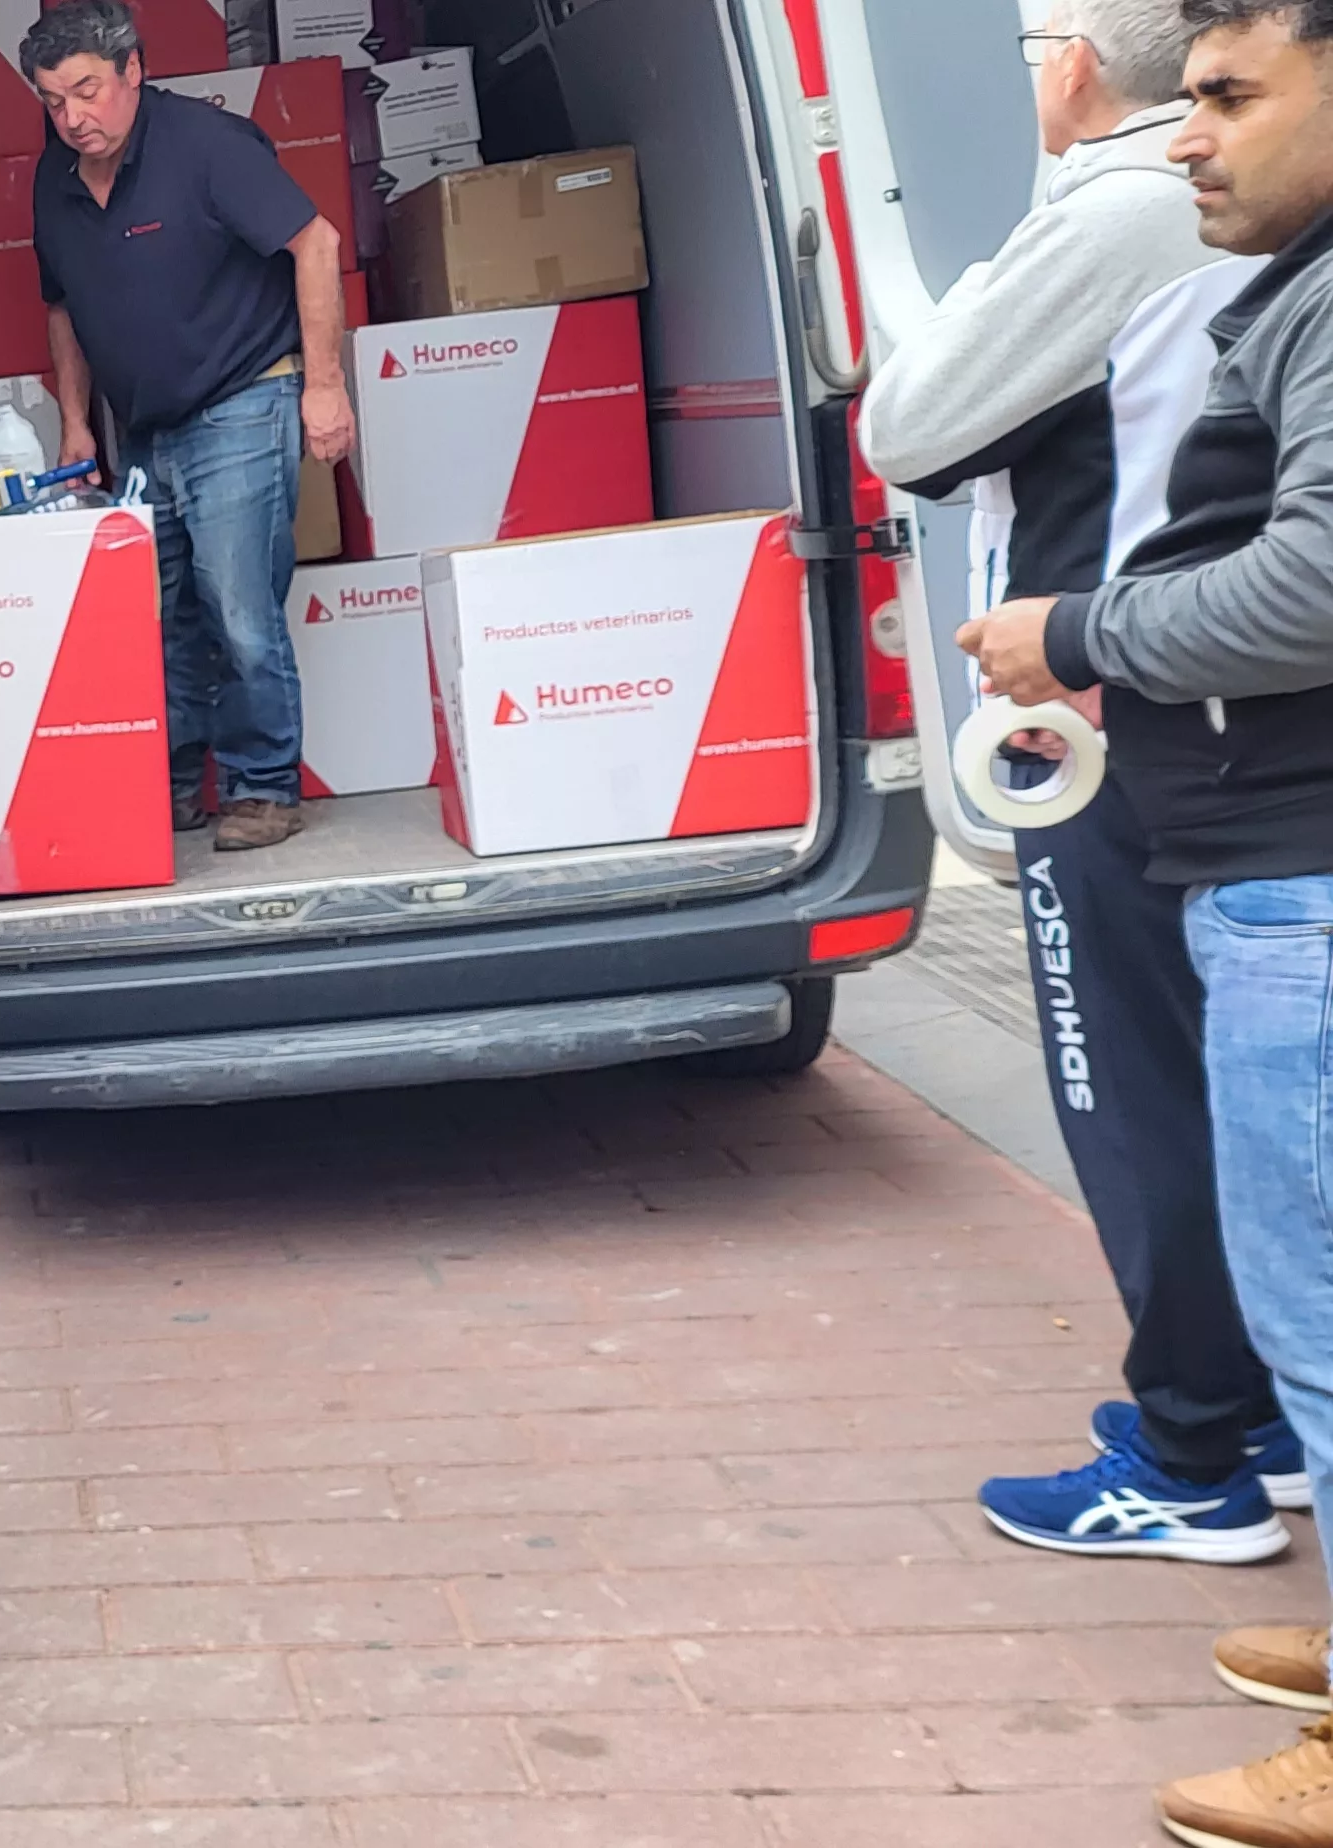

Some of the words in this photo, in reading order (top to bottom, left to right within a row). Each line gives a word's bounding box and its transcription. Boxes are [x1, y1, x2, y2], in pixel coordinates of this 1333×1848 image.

[413, 338, 518, 365] Humeco
[339, 586, 421, 608] Hume
[484, 620, 578, 642] Productos
[584, 607, 694, 632] veterinarios
[536, 677, 674, 709] Humeco
[36, 718, 158, 738] www.humeco.net
[1026, 856, 1095, 1113] SDHUESCA
